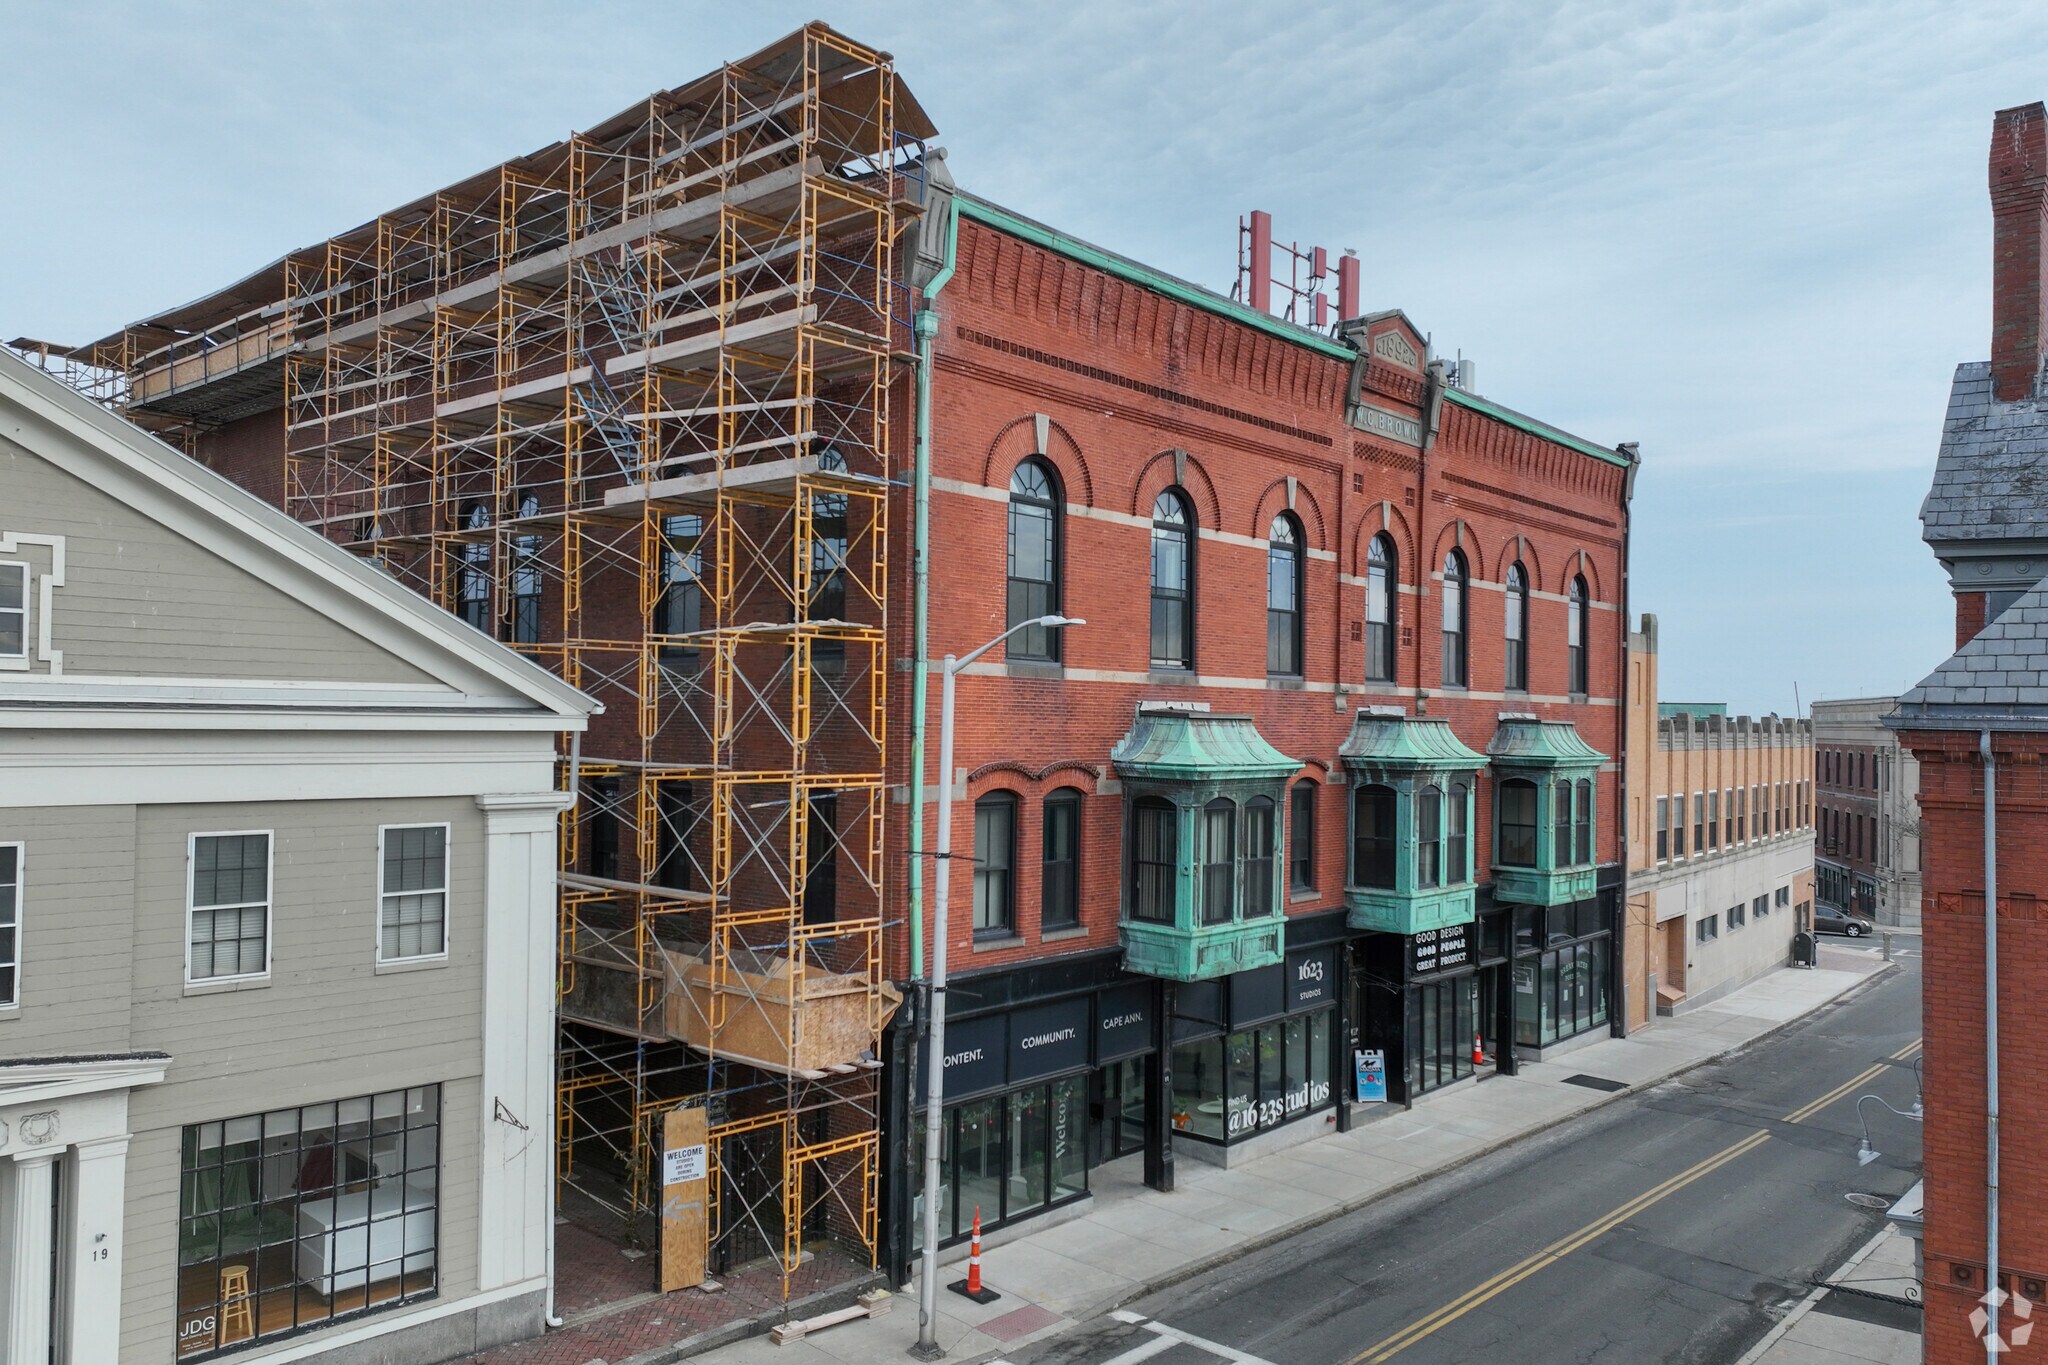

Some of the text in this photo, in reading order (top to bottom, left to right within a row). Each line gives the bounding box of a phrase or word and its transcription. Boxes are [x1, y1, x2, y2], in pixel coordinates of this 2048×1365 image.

[1381, 337, 1409, 365] 1892
[1379, 415, 1418, 441] BROWN
[1415, 925, 1464, 944] GOOD DESIGN
[1417, 938, 1466, 957] GOOD PEOPLE
[1298, 959, 1324, 981] 1623
[1416, 952, 1467, 971] GREAT PRODUCT
[1300, 988, 1322, 1001] STUDIOS
[1103, 1012, 1144, 1030] CAPE ANN.
[1021, 1028, 1076, 1049] COMMUNITY.
[943, 1048, 984, 1068] ONTENT.
[1228, 1094, 1248, 1107] FIND US
[667, 1147, 703, 1160] WELCOME
[670, 1173, 699, 1182] CONSTRUCTION
[180, 1315, 215, 1337] JDG
